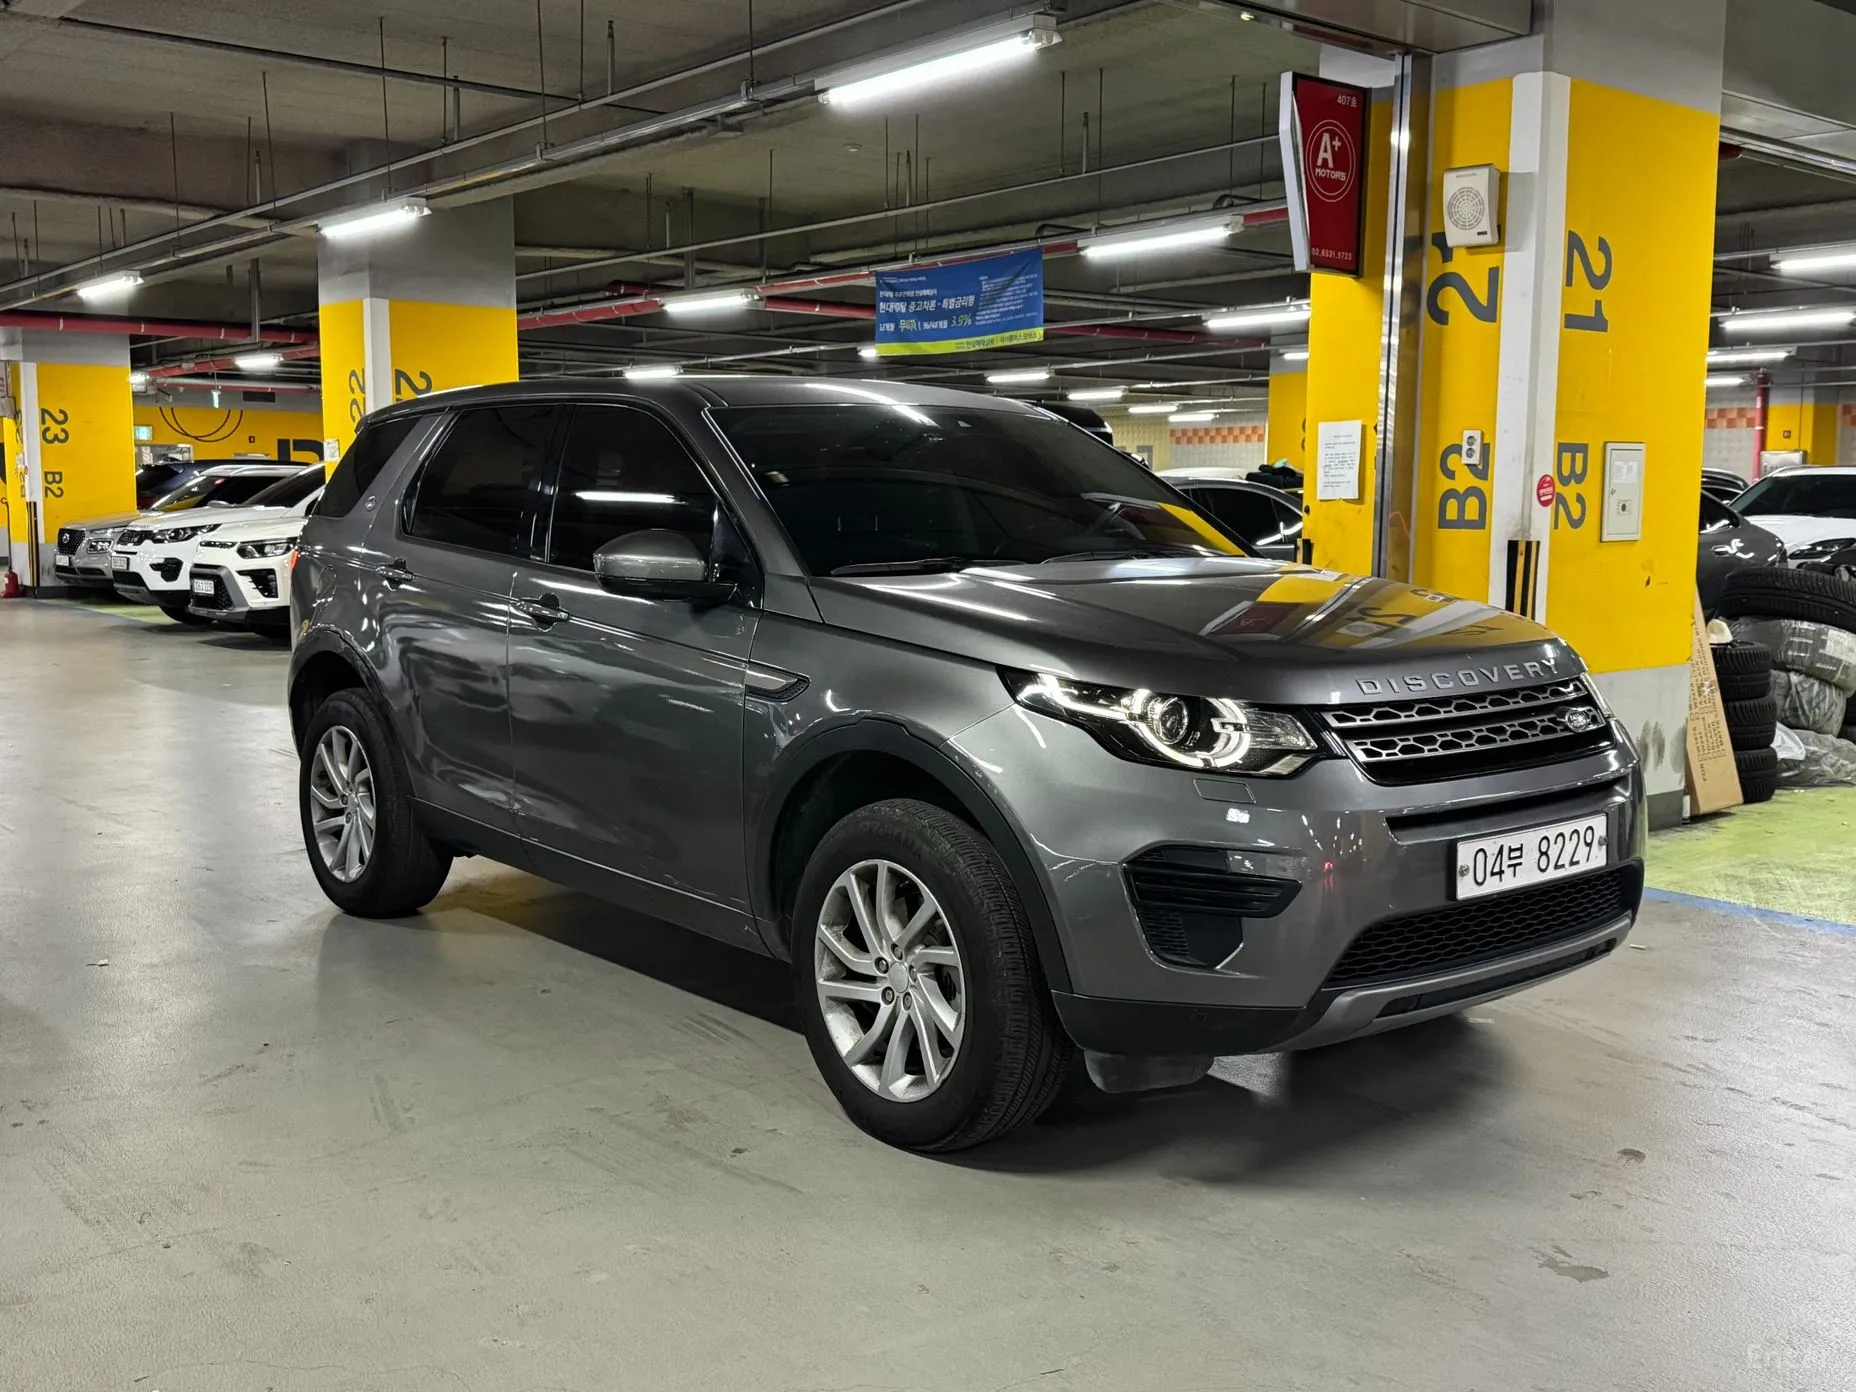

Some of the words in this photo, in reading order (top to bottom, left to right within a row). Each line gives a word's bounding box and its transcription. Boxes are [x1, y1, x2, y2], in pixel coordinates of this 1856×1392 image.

[1317, 132, 1341, 168] A+
[1315, 167, 1346, 181] MOTORS
[1564, 230, 1612, 332] 21
[395, 369, 432, 402] 2
[41, 407, 69, 445] 23
[44, 471, 64, 498] B2
[1438, 442, 1491, 529] B2
[1554, 443, 1588, 529] B2
[1356, 658, 1558, 695] DISCOVERY
[1473, 843, 1524, 886] 04부
[1537, 825, 1595, 873] 8229
